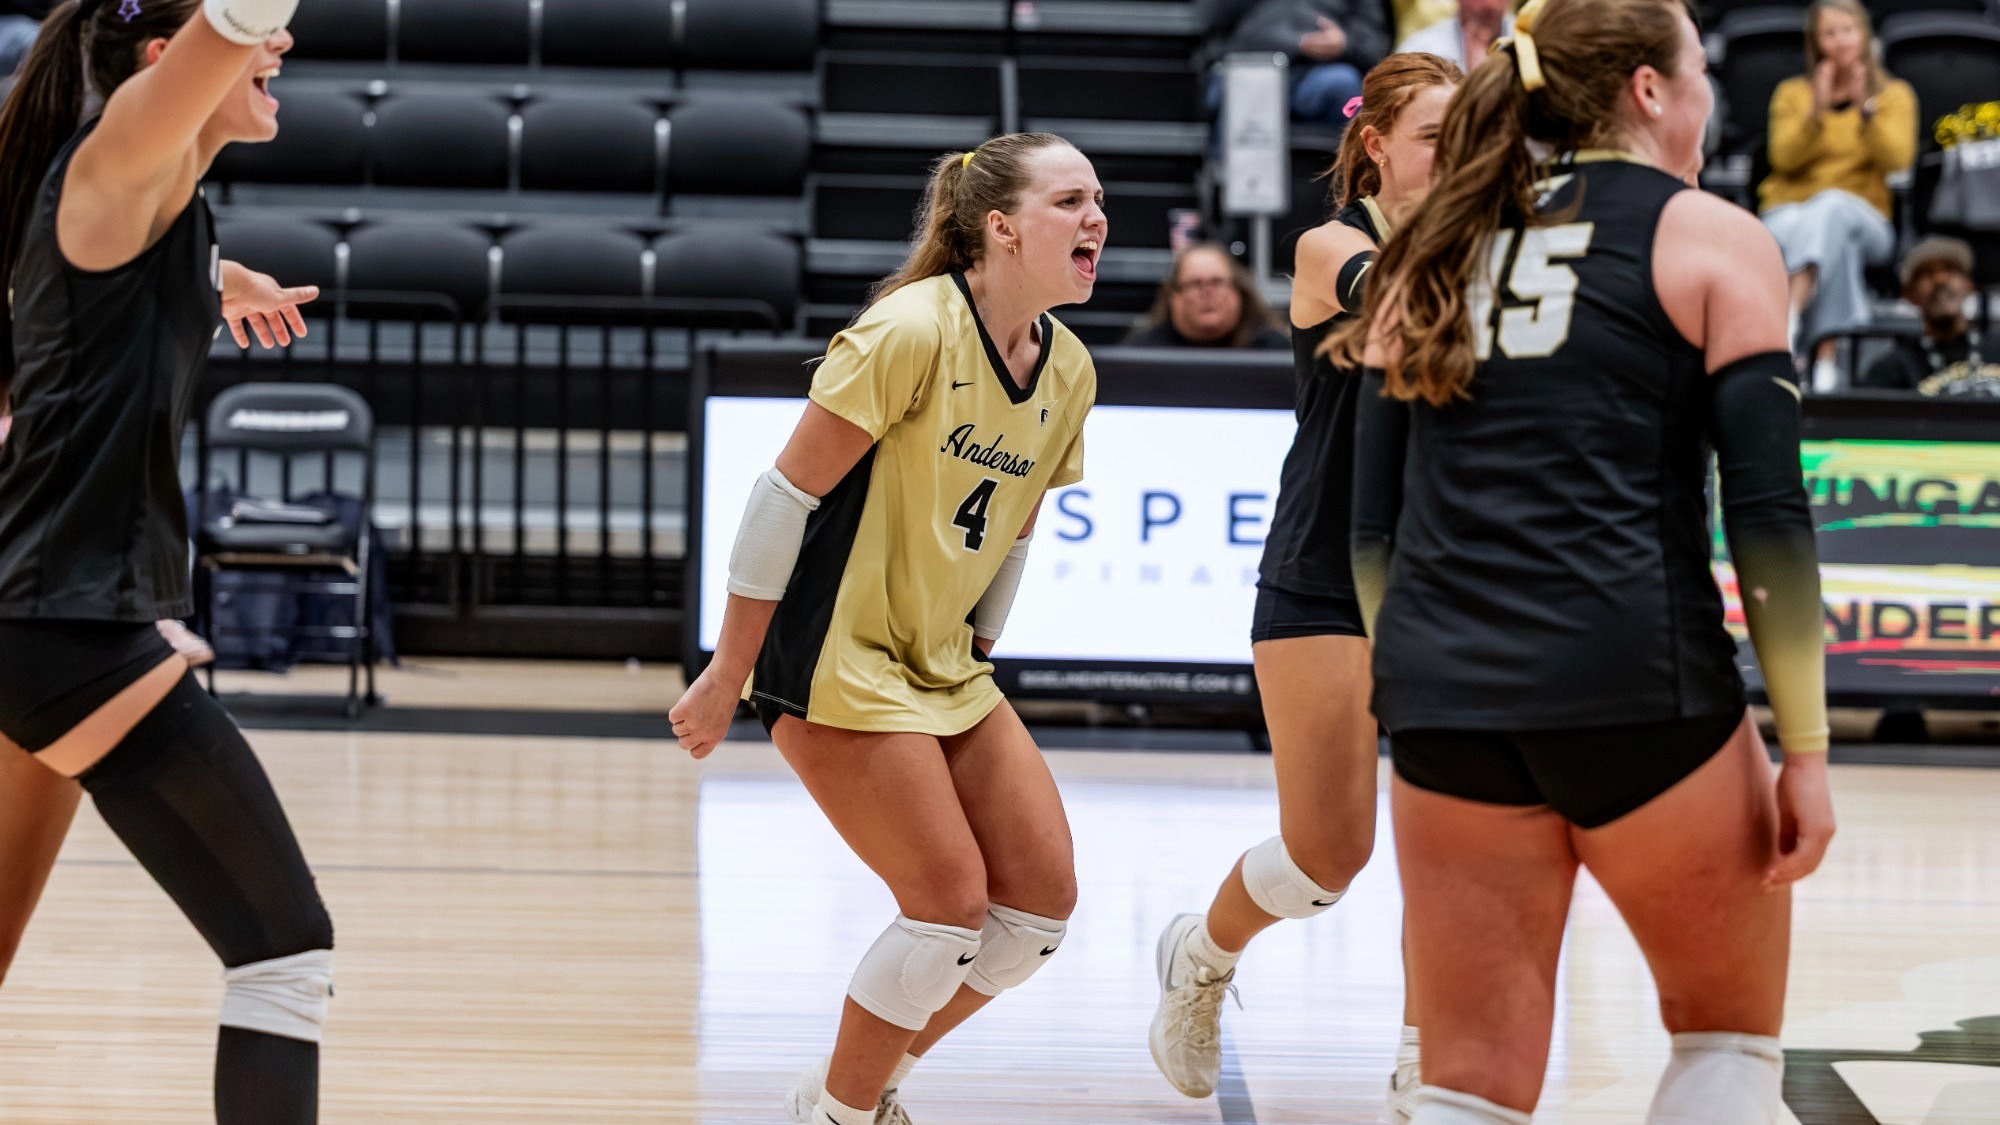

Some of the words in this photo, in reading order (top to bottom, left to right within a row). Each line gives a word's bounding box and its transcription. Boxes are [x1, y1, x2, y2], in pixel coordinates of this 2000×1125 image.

[1465, 221, 1595, 361] 15
[950, 475, 1000, 554] 4
[1805, 475, 2000, 513] INGA
